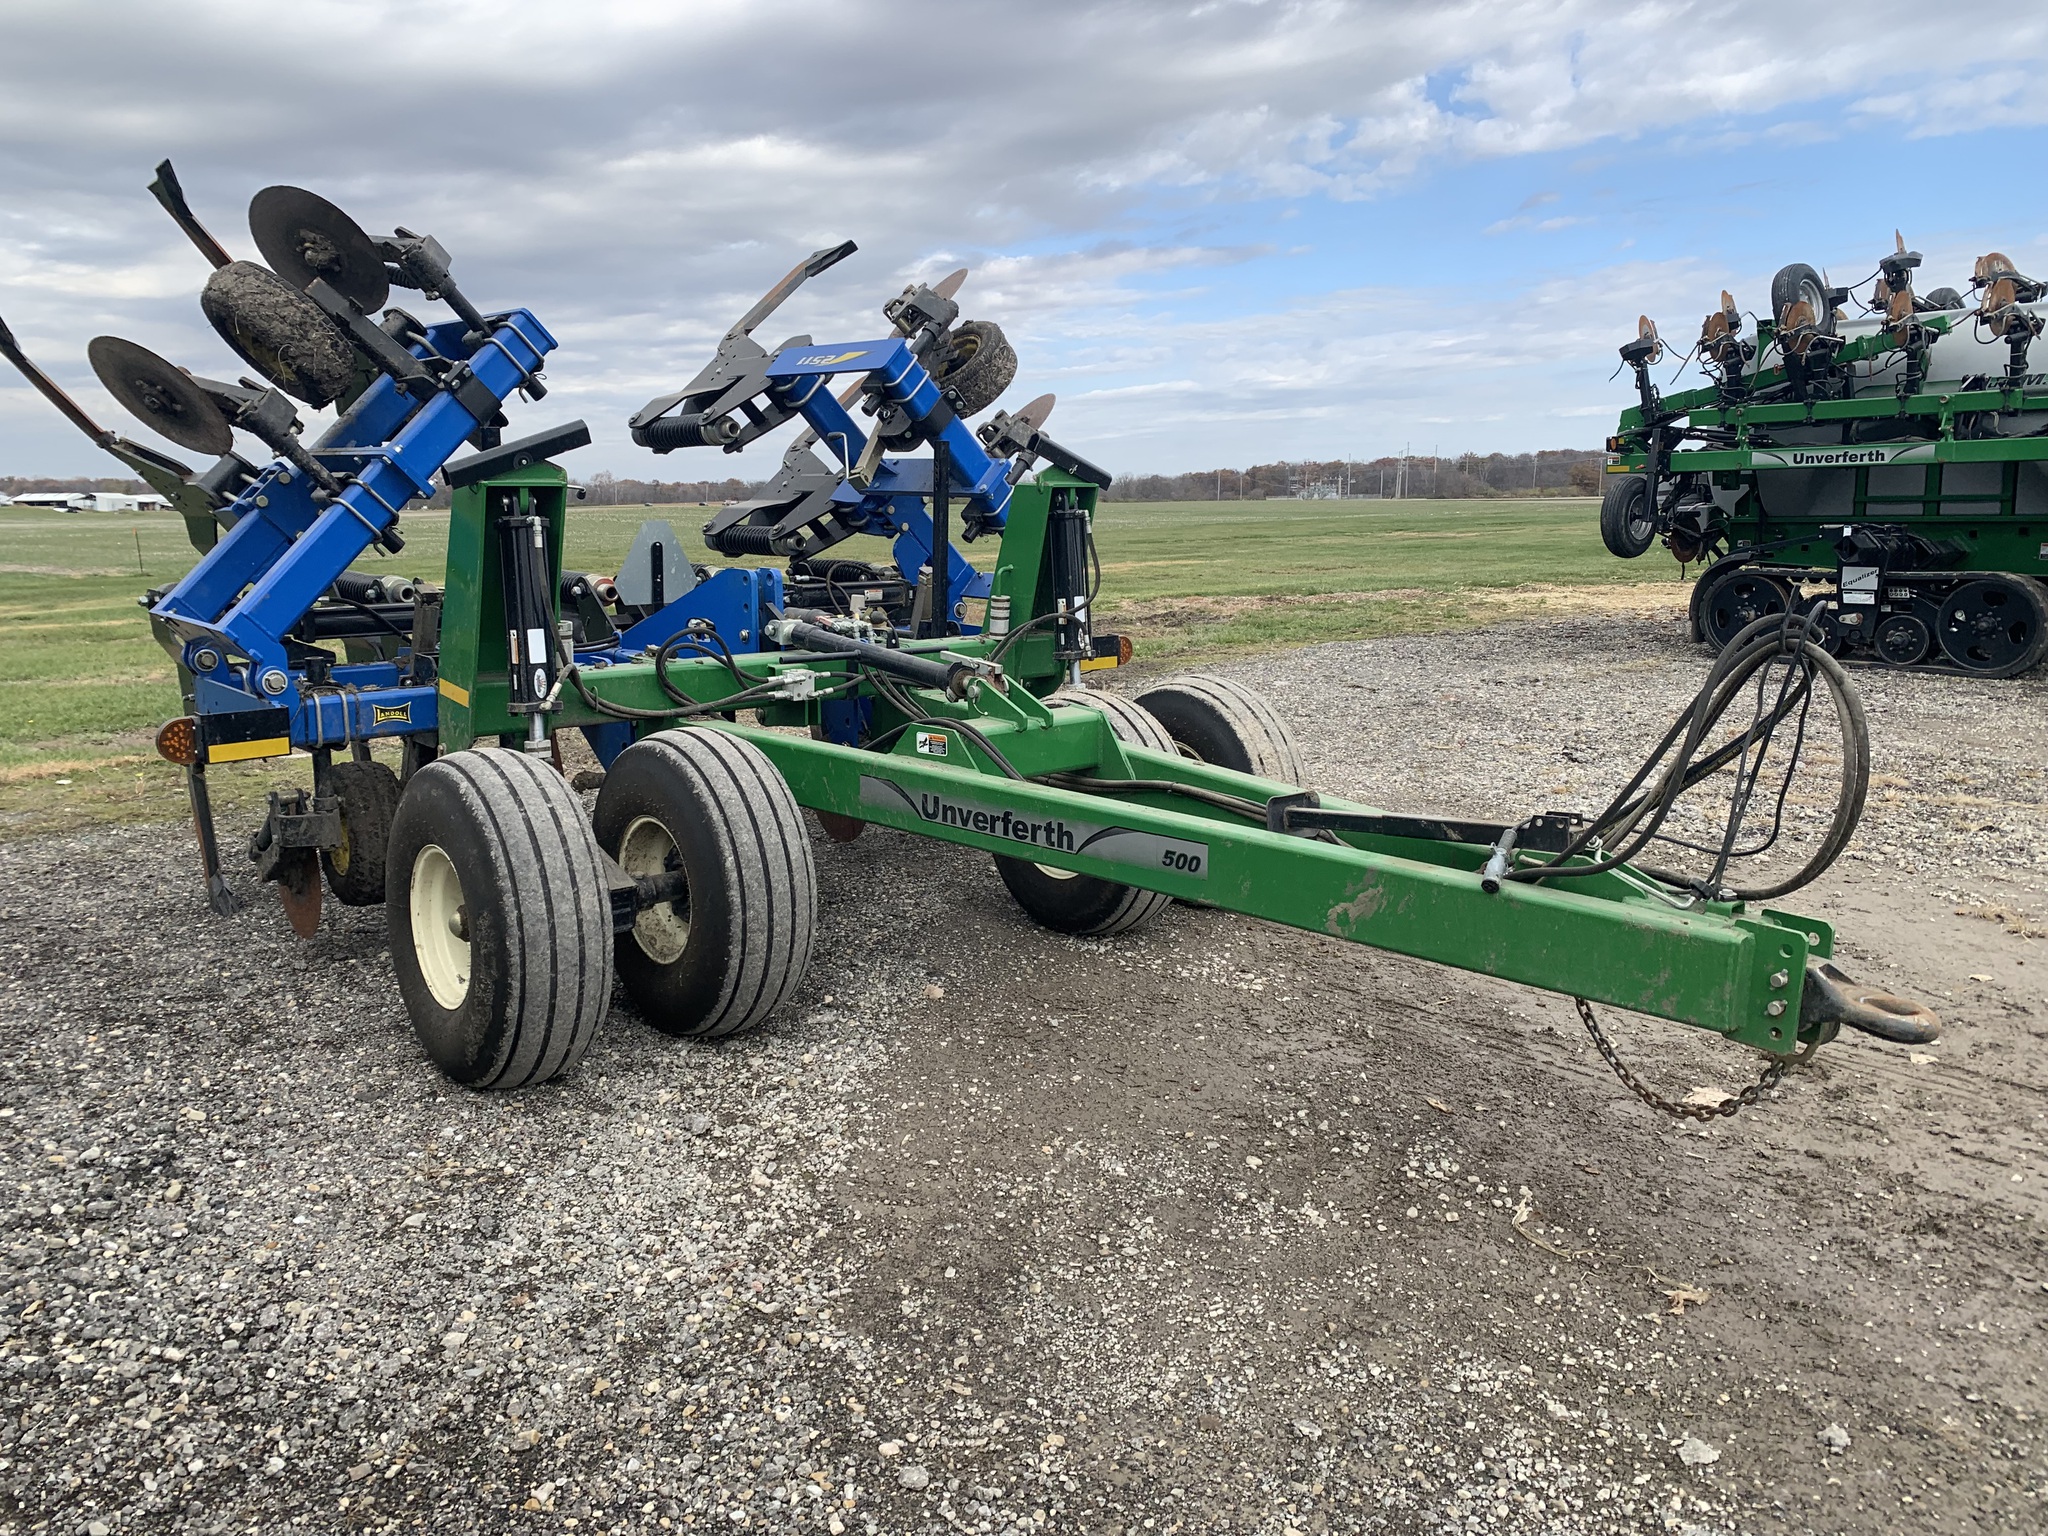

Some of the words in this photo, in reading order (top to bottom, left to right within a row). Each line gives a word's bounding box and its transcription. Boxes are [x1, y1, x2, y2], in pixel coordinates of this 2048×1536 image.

[1793, 450, 1885, 465] Unverferth
[1842, 569, 1878, 587] Equalizer
[921, 793, 1074, 851] Unverferth
[1161, 850, 1201, 873] 500
